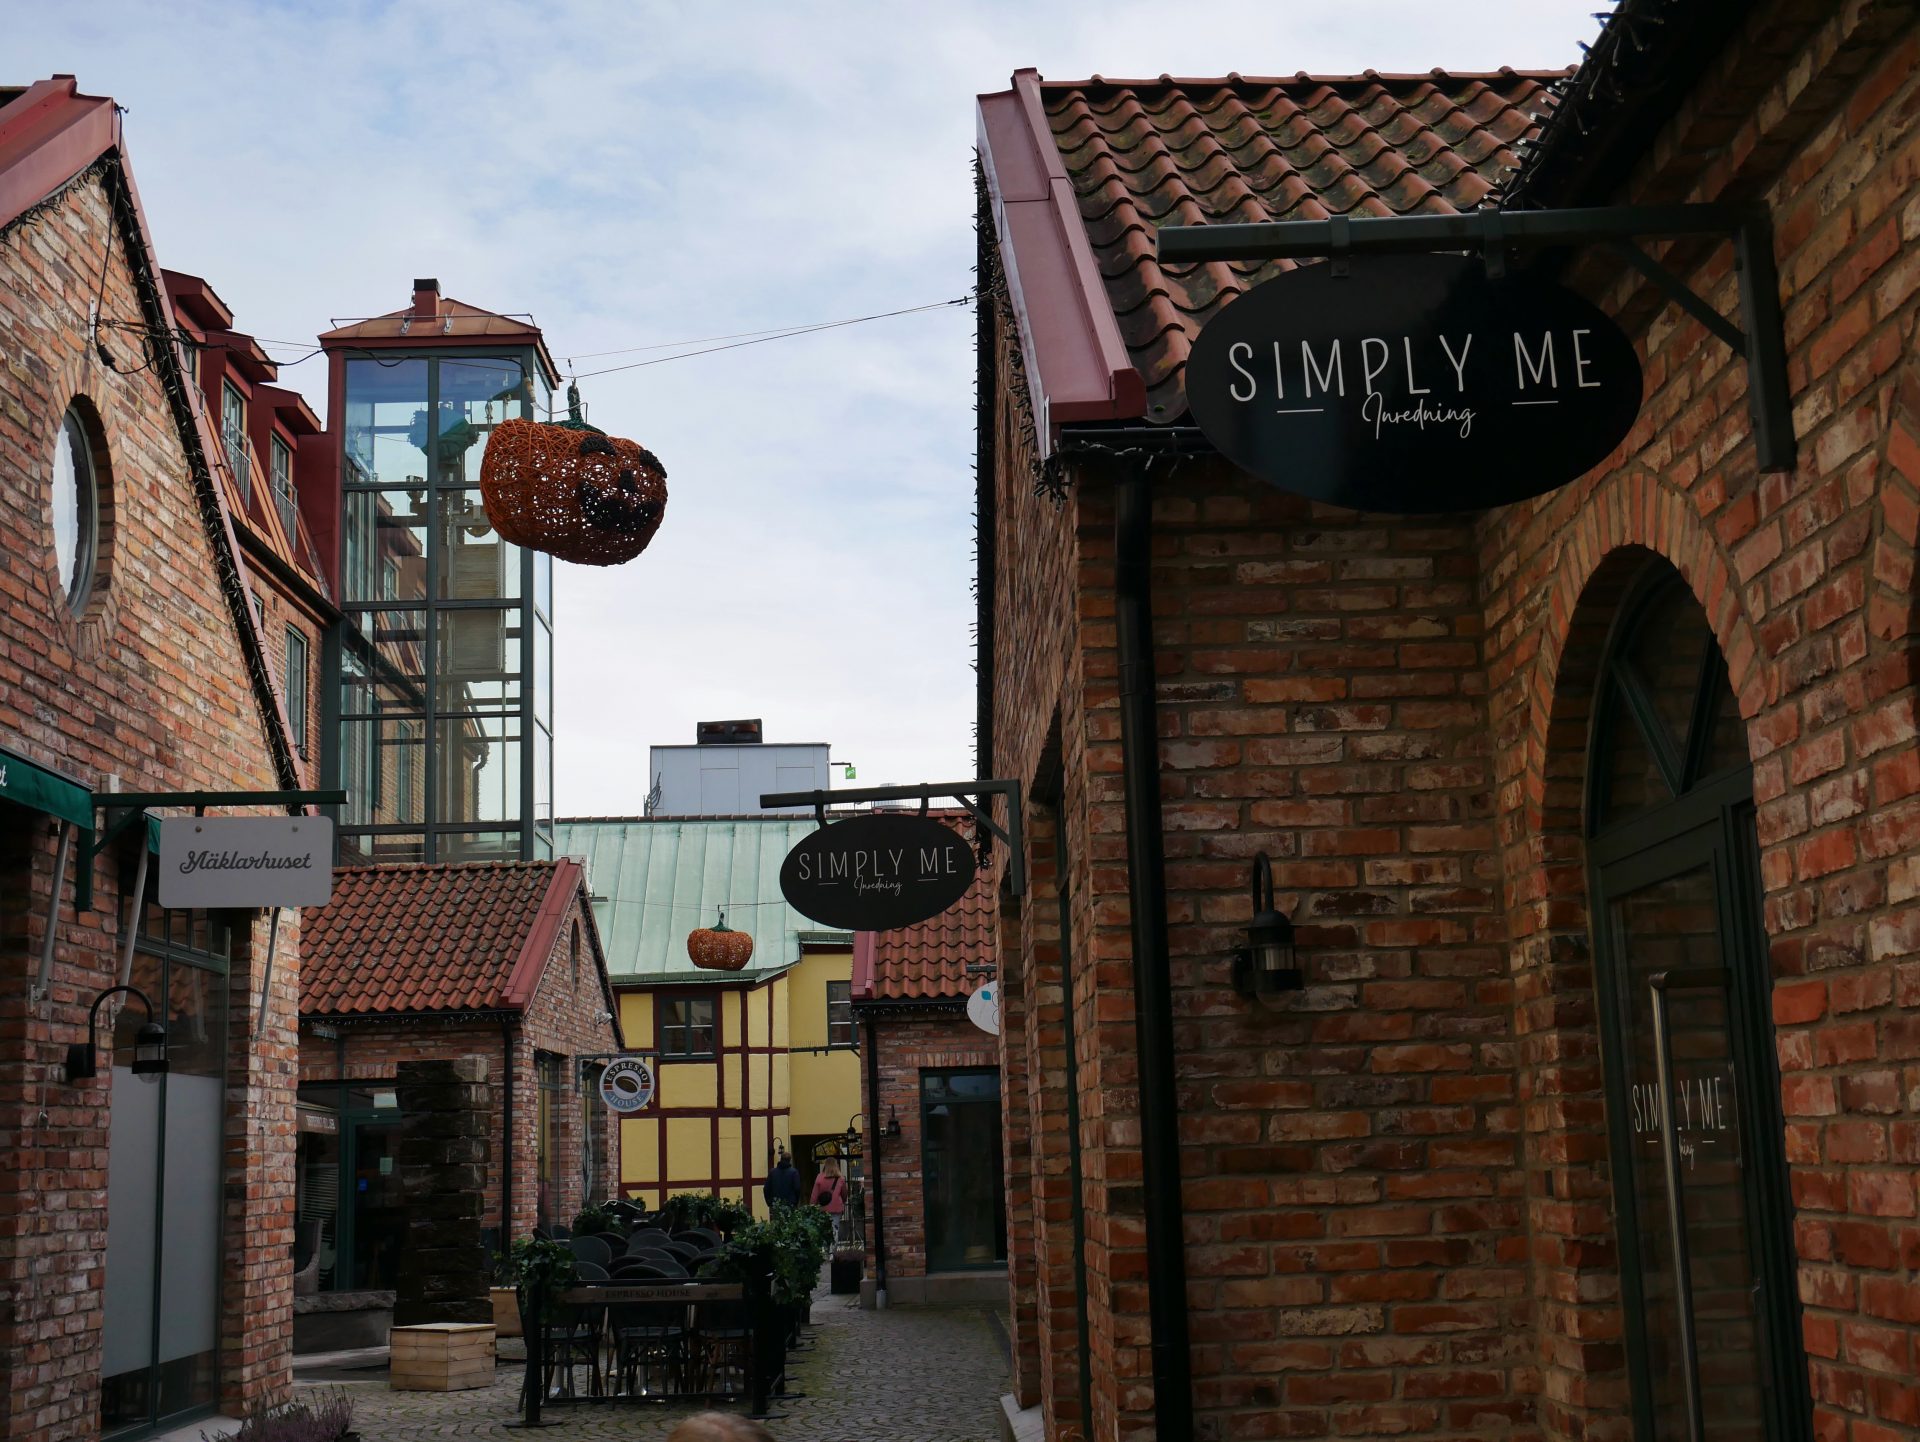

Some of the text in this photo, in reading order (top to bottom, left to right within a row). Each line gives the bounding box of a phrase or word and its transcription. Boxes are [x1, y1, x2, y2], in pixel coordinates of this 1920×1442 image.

[1228, 329, 1601, 402] SIMPLY ME
[1361, 391, 1477, 440] Inredning
[179, 850, 313, 875] Mäklarhuset
[798, 846, 957, 881] SIMPLY ME
[853, 874, 904, 897] Inredning
[605, 1062, 648, 1081] ESPRESSO
[610, 1094, 644, 1107] HOUSE
[1632, 1076, 1726, 1133] SIMY ME
[605, 1288, 691, 1298] ESPRESSO HOUSE
